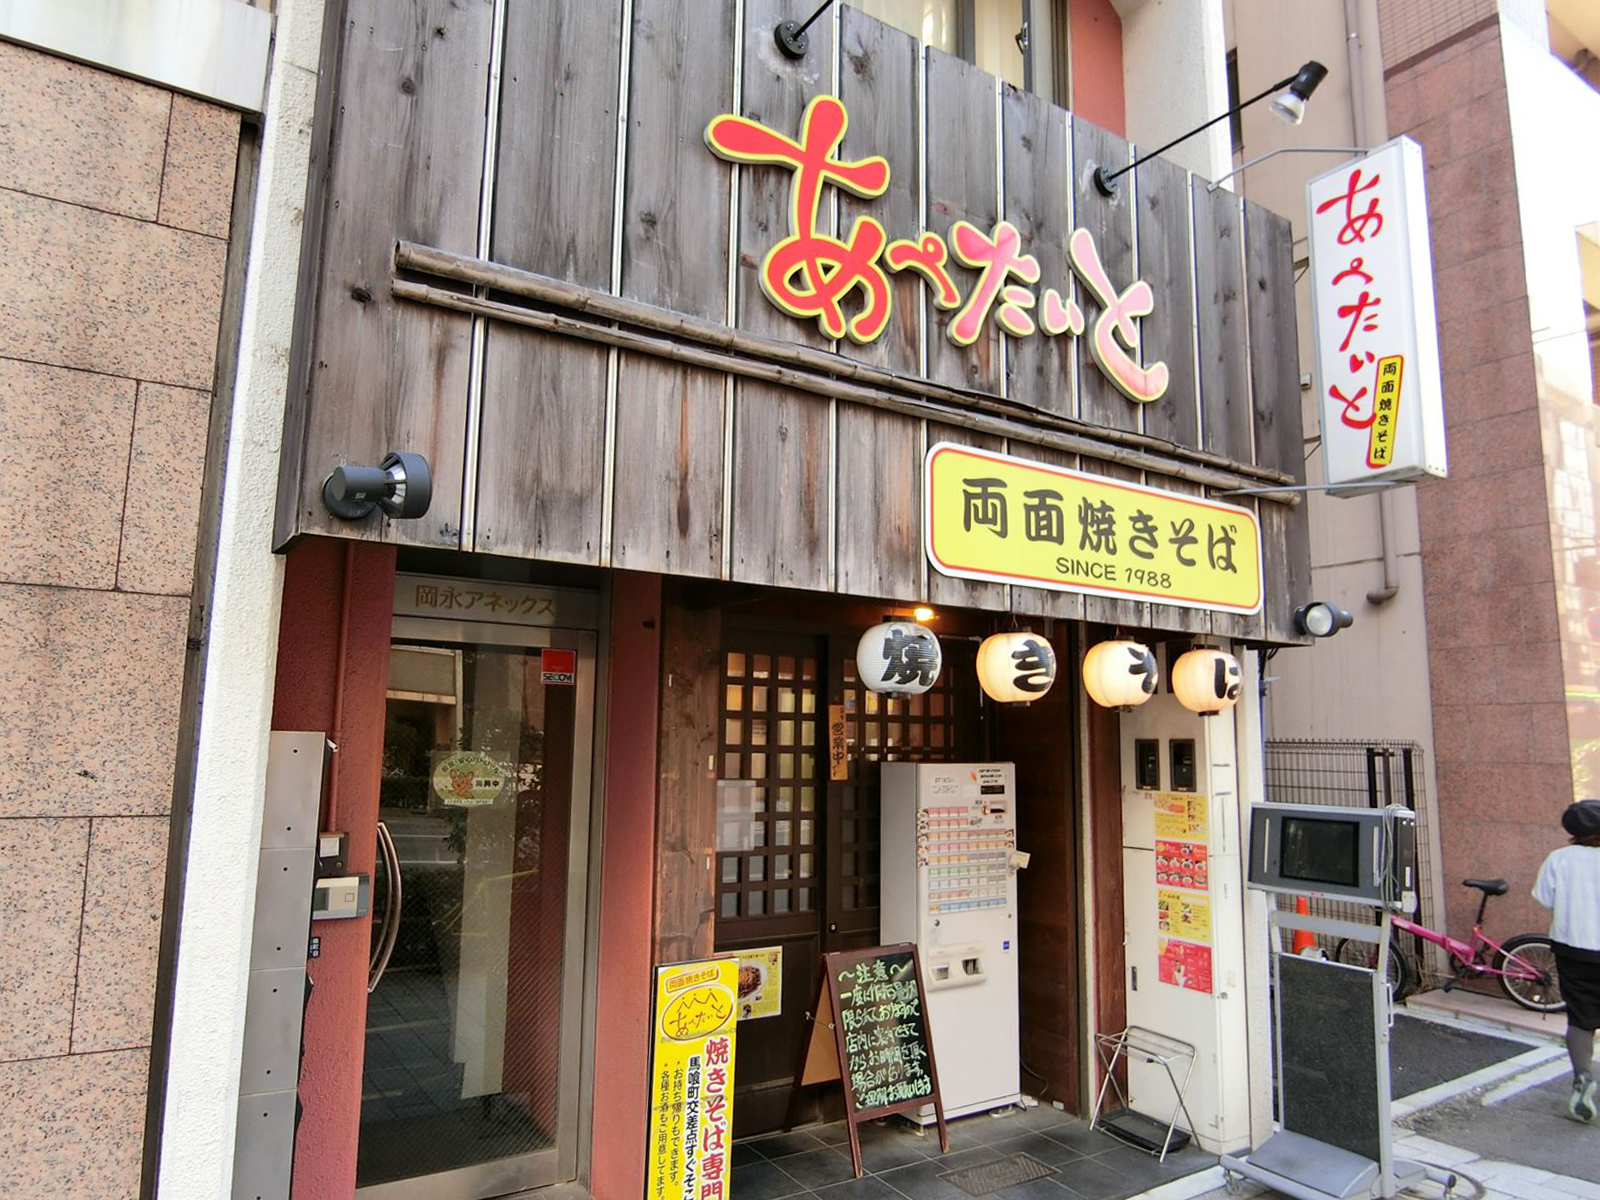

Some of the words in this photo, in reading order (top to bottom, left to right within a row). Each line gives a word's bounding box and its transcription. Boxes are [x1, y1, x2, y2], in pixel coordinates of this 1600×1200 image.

[704, 94, 1169, 403] あぺたいと
[1316, 168, 1384, 430] あぺたいと
[1373, 361, 1398, 461] 両面焼きそば
[962, 477, 1238, 574] 両面焼きそば
[1055, 556, 1116, 581] SINCE
[1125, 567, 1172, 589] 1988
[414, 584, 555, 617] 岡永アネックス
[542, 672, 572, 682] SECOM
[881, 629, 938, 687] 焼
[700, 1037, 730, 1200] 焼きそば専門
